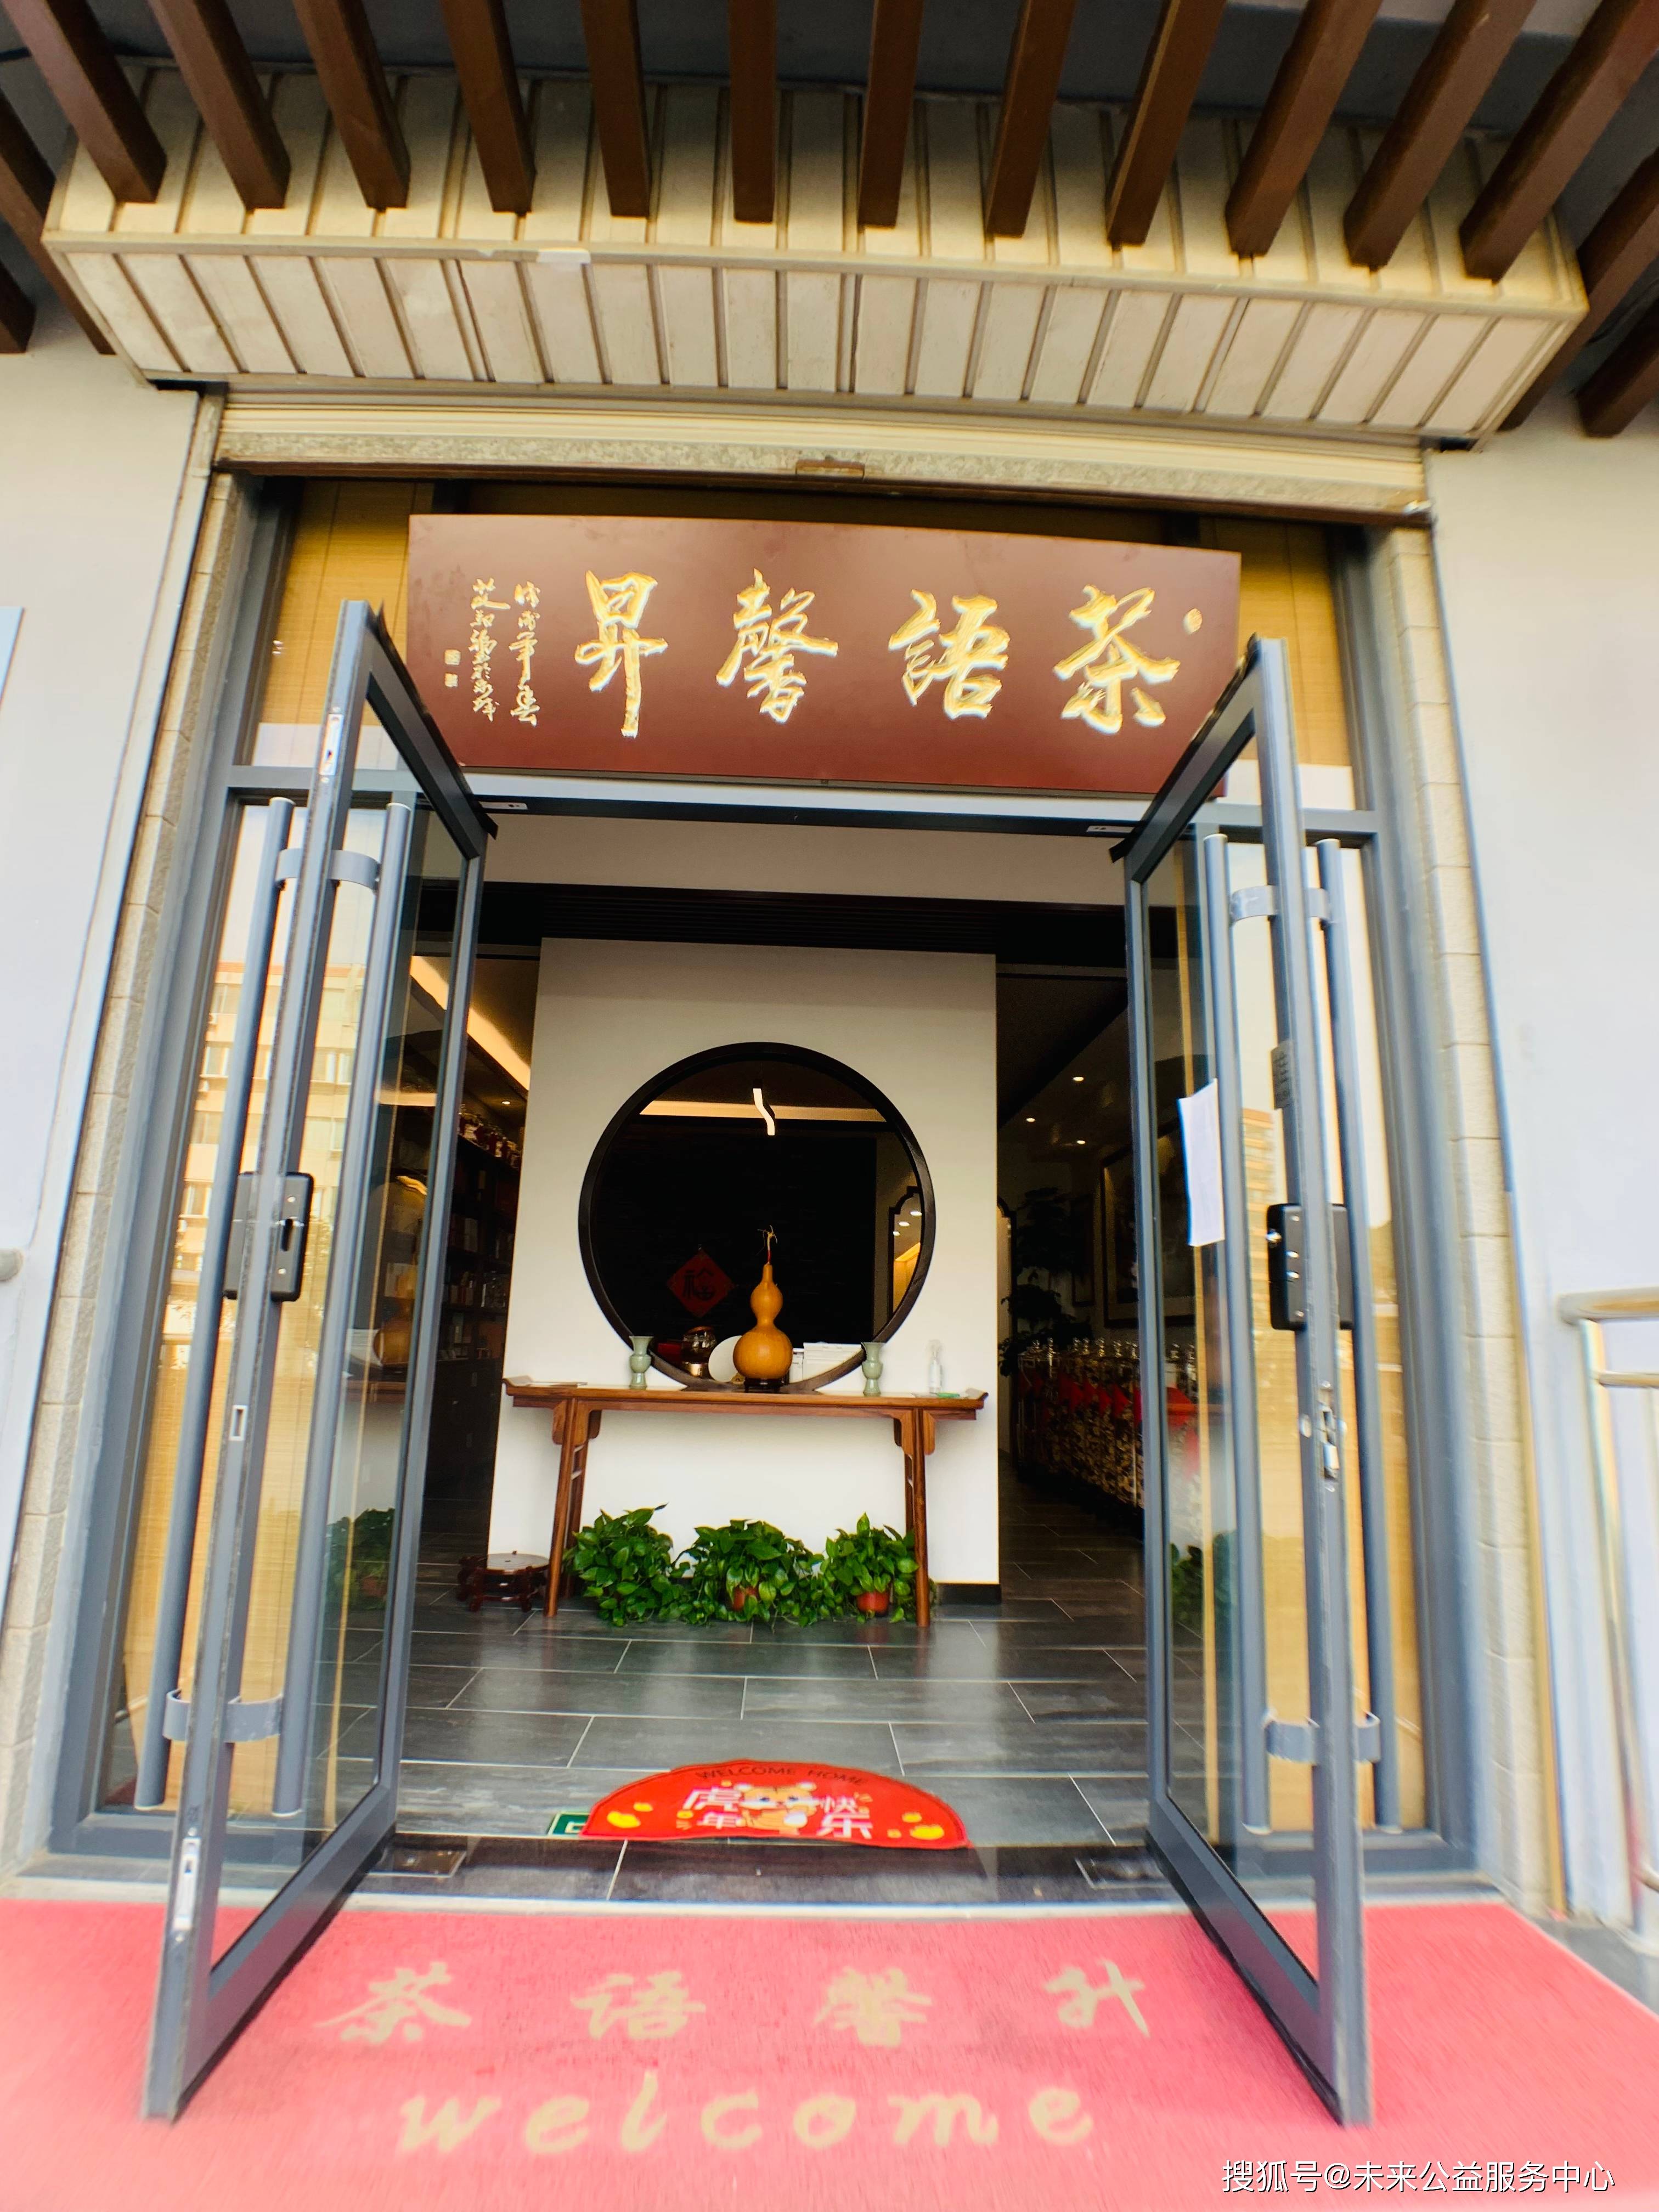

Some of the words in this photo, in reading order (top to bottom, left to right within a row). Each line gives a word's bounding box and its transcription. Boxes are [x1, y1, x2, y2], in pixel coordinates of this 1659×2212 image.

[682, 1267, 716, 1301] 福
[696, 1766, 797, 1780] WELCOME
[807, 1768, 865, 1784] HOME
[315, 1960, 1151, 2048] 茶语馨升
[396, 2069, 1094, 2155] welcome
